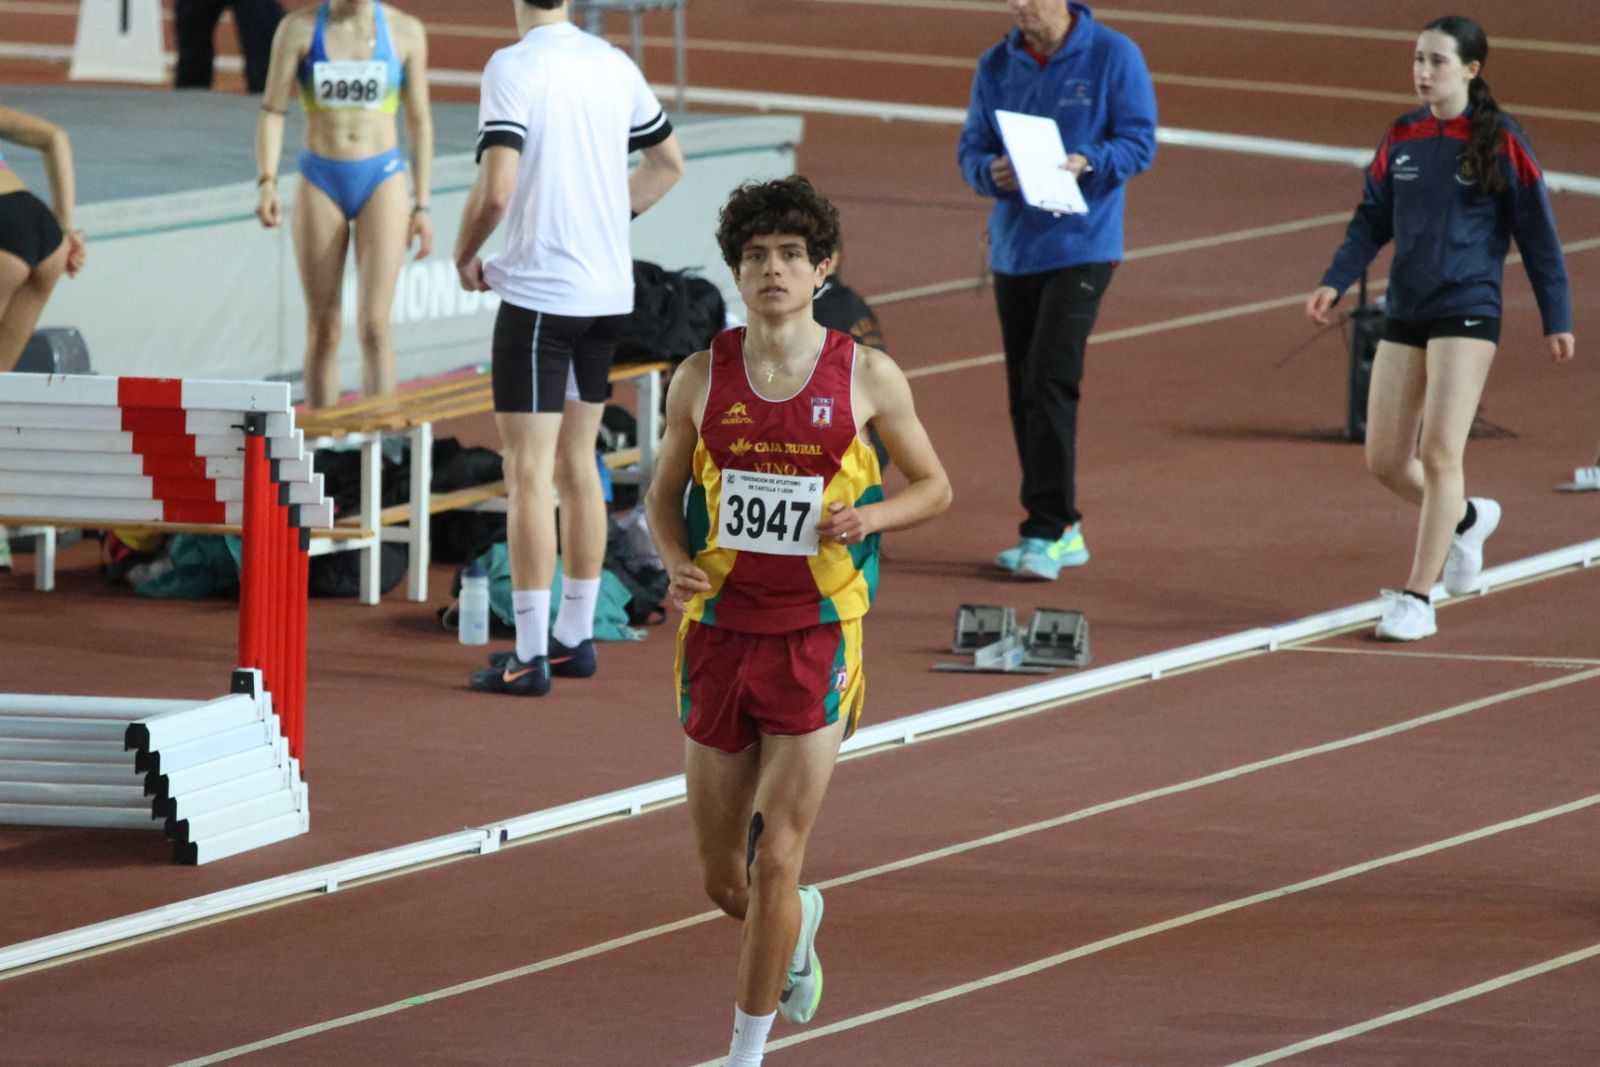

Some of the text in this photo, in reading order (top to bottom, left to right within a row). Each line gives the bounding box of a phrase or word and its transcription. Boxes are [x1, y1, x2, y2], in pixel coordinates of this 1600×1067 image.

[754, 442, 823, 455] CAJA RURAL
[754, 462, 797, 476] VINO
[775, 479, 801, 487] ATLETISMO
[726, 494, 811, 542] 3947
